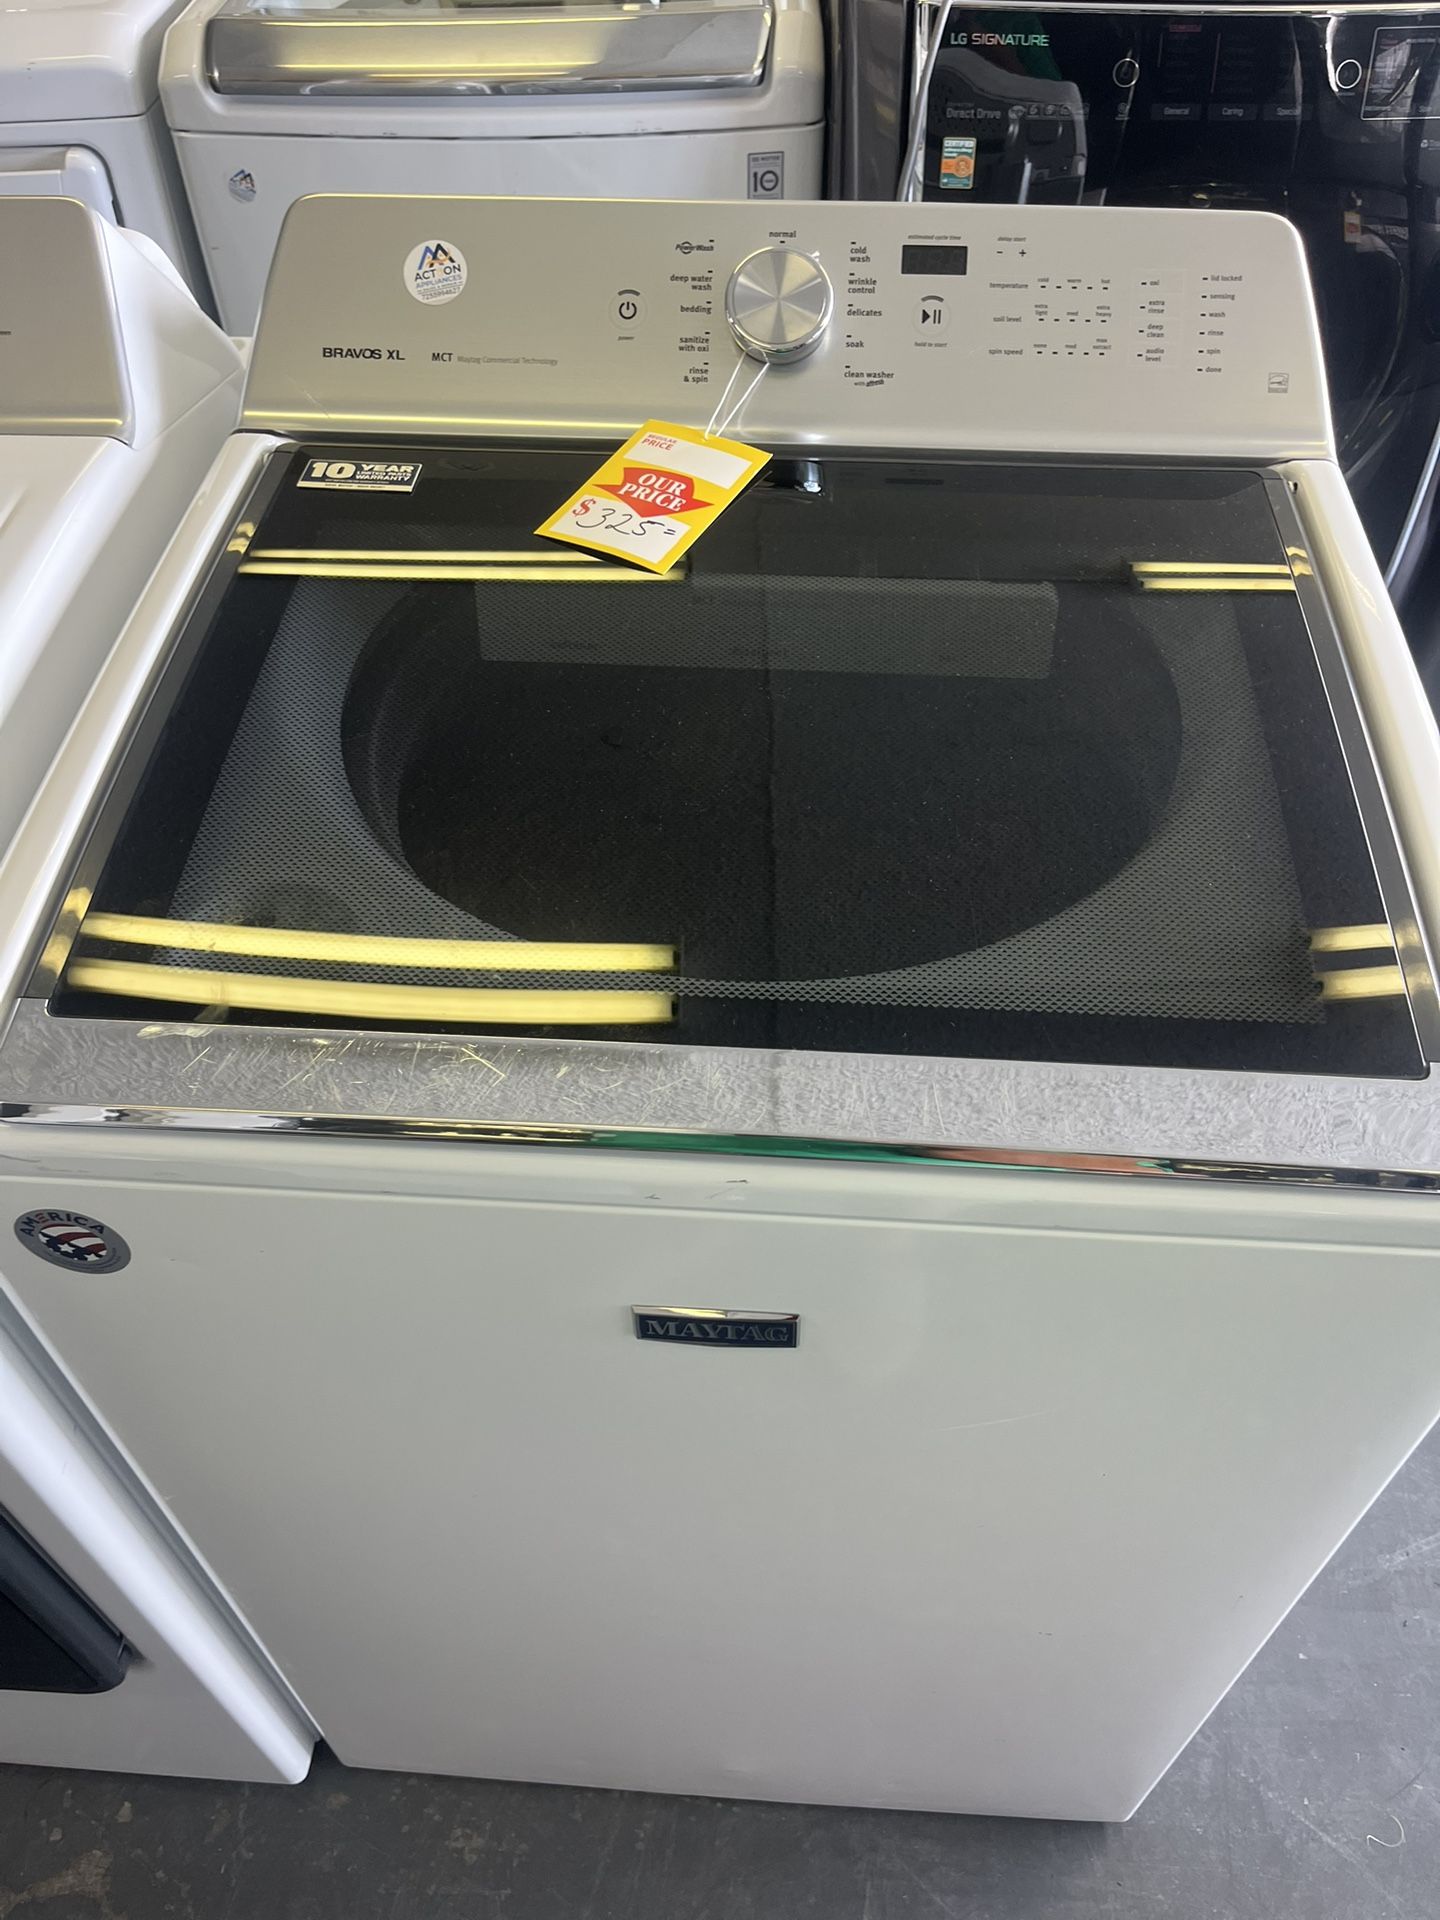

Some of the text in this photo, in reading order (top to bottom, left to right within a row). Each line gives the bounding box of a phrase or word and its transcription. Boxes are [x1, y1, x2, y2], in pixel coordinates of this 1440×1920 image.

[950, 32, 1050, 46] LG SIGNATURE
[946, 107, 1001, 119] Direct Drive
[769, 230, 797, 238] normal
[850, 246, 867, 254] cold
[850, 255, 871, 263] wash
[670, 274, 713, 283] deep water
[848, 278, 877, 286] wrinkle
[691, 283, 712, 291] wash
[847, 286, 876, 294] control
[1210, 293, 1235, 301] sensing
[680, 305, 712, 315] bedding
[847, 308, 882, 317] delicates
[1147, 323, 1163, 331] deep
[680, 336, 710, 344] sanitize
[845, 340, 865, 348] soak
[678, 344, 695, 352] with
[322, 347, 406, 361] BRAVOS XL
[431, 352, 453, 362] MCT
[689, 366, 709, 374] rinse
[844, 370, 895, 379] clean washer
[691, 375, 709, 384] spin
[641, 438, 674, 451] PRICE
[310, 462, 415, 479] 10 YEAR
[638, 473, 687, 497] OUR
[618, 483, 687, 512] PRICE
[20, 1211, 105, 1237] AMERICA
[646, 1320, 789, 1342] MAYTAG
